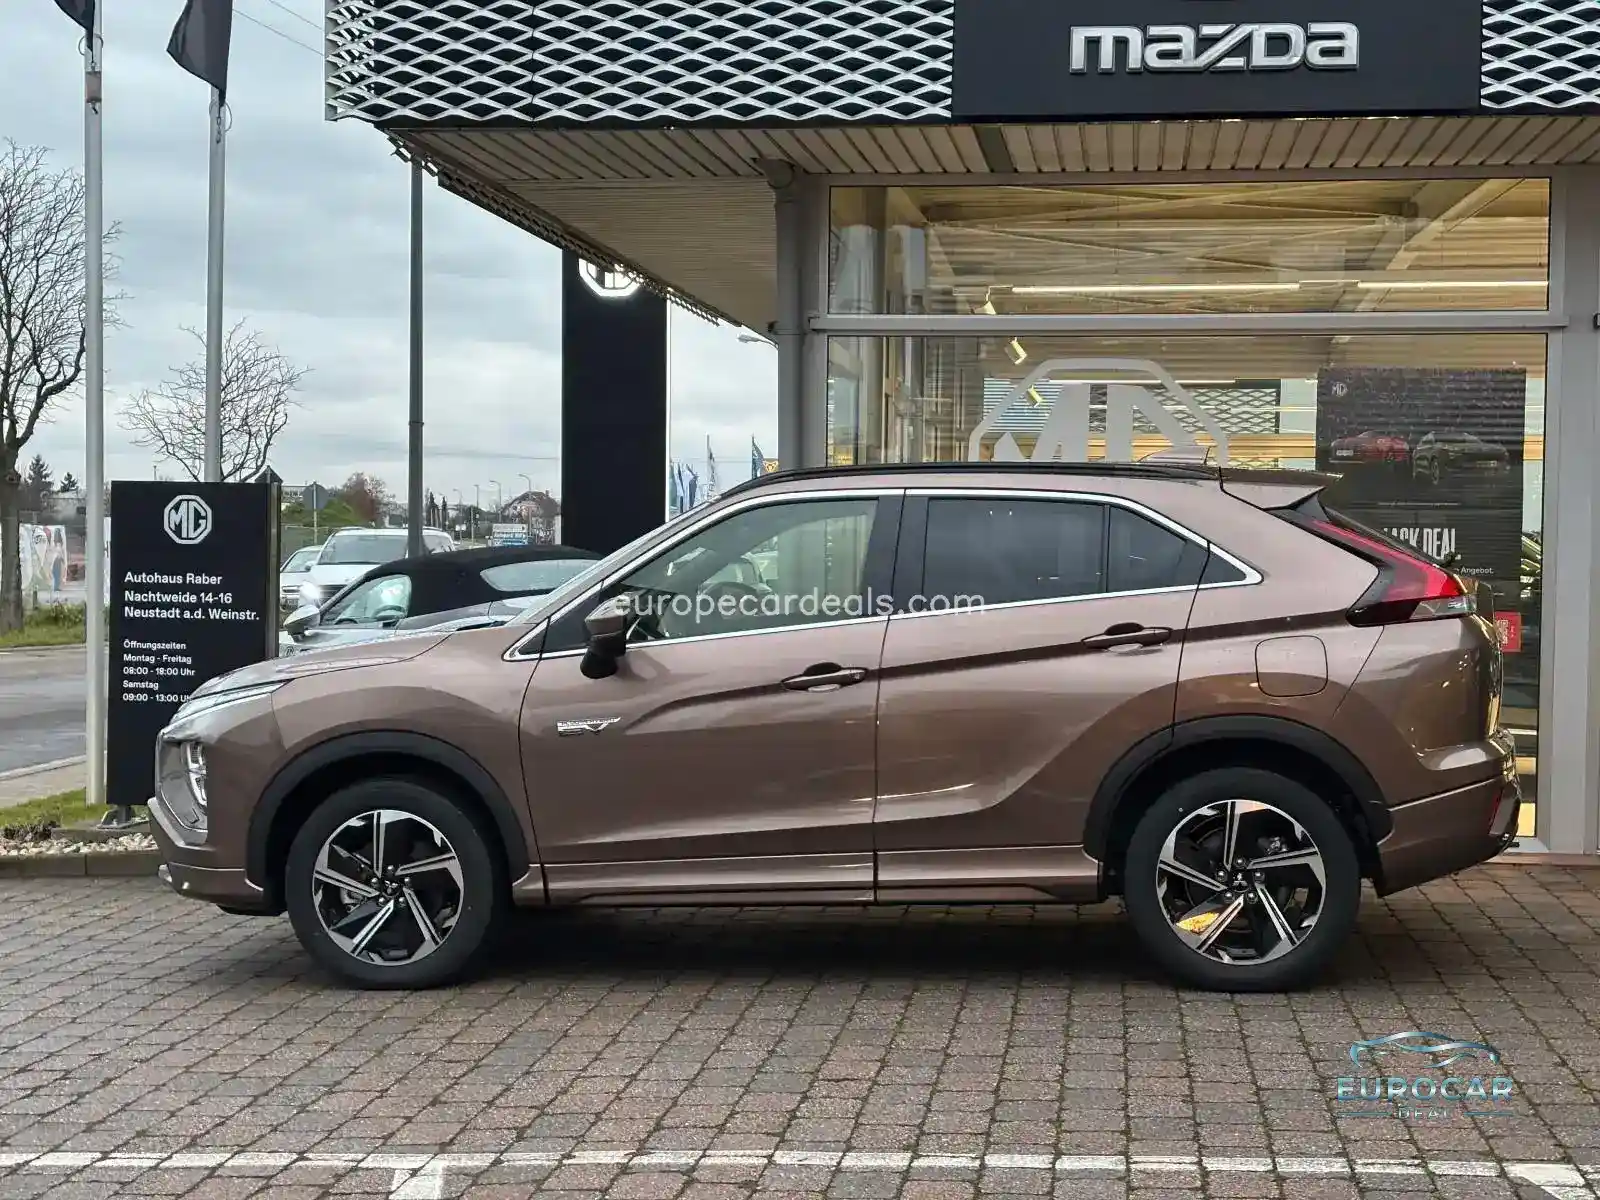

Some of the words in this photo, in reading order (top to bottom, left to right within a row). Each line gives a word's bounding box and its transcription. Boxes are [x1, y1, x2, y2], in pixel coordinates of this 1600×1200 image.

[168, 500, 206, 539] MG
[124, 571, 183, 584] Autohaus
[186, 573, 222, 585] Raber
[124, 590, 197, 603] Nachtweide
[200, 592, 232, 604] 14-16
[124, 606, 180, 619] Neustadt
[183, 608, 205, 619] a.d.
[208, 608, 260, 620] Weinstr.
[123, 639, 187, 650] Öffnungszeiten
[123, 653, 155, 663] Montag
[162, 654, 192, 664] Freitag
[123, 666, 148, 675] 08:00
[155, 667, 178, 676] 18:00
[180, 668, 196, 676] Uhr
[122, 680, 159, 690] Samstag
[122, 693, 148, 702] 09:00
[155, 694, 178, 702] 13:00
